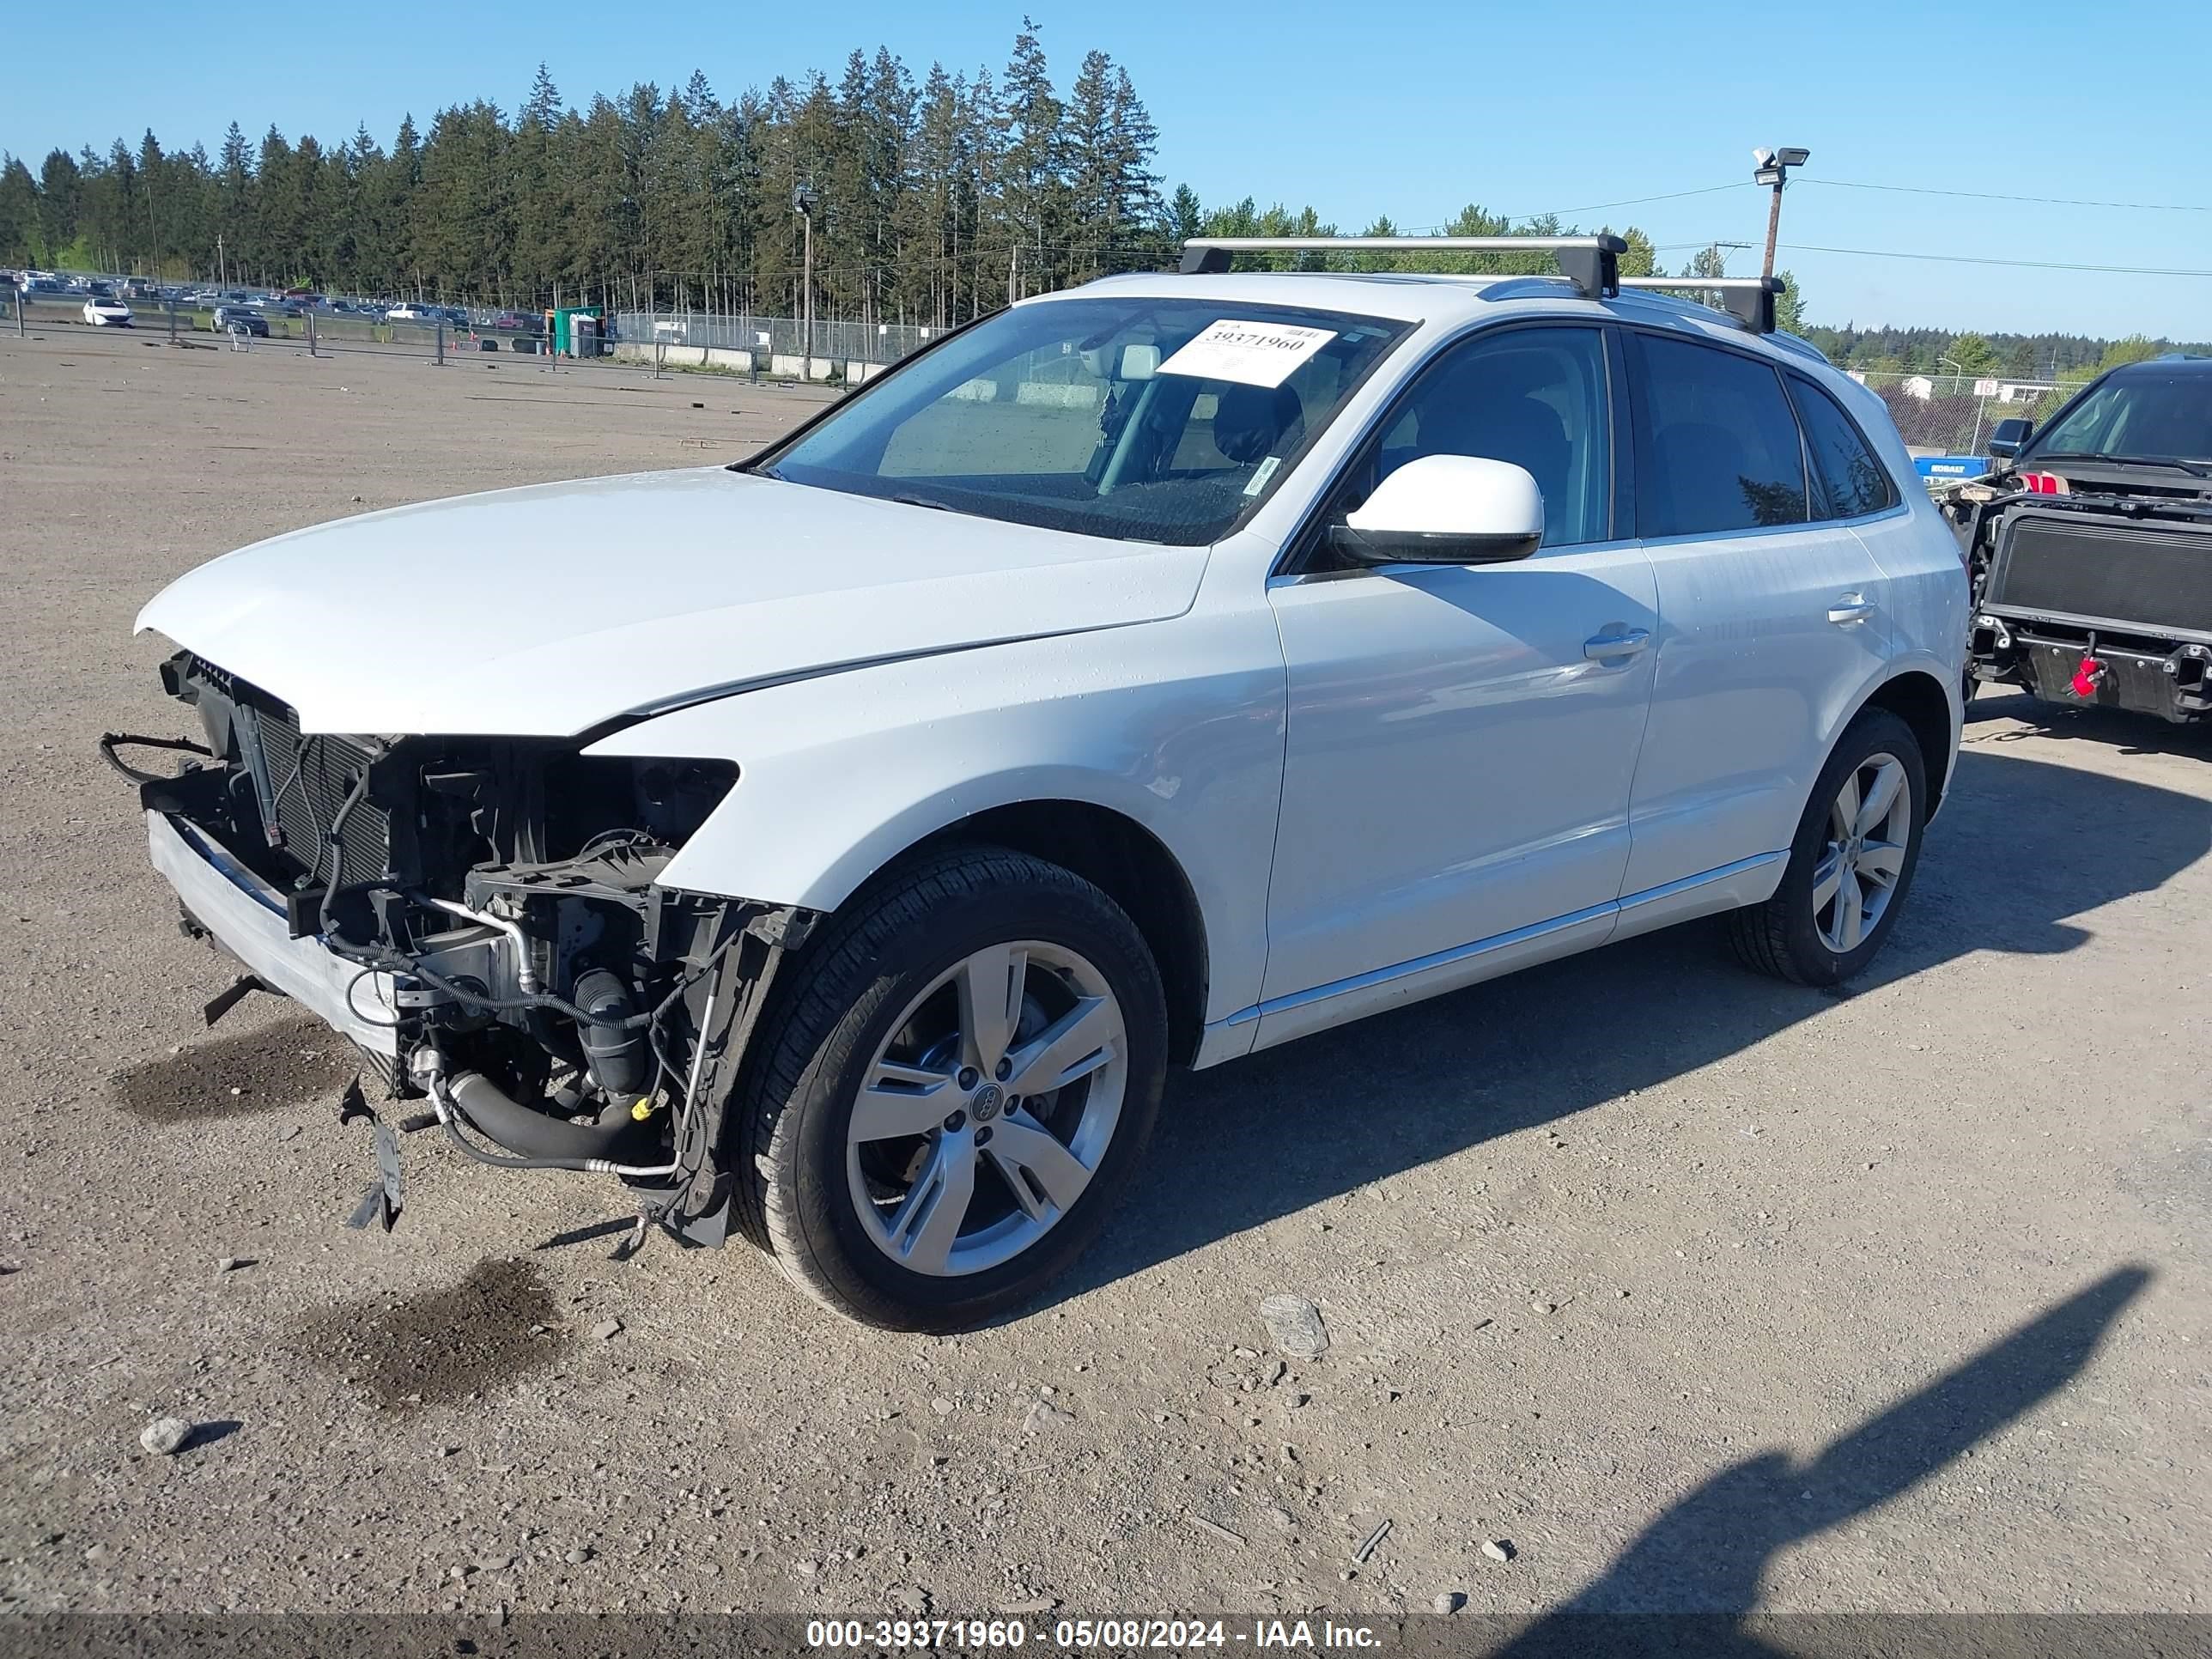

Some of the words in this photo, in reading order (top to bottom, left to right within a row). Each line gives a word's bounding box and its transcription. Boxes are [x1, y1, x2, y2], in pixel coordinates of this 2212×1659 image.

[1206, 331, 1305, 351] 39371960
[1978, 381, 1993, 394] 16
[1931, 465, 1966, 473] KOBALT
